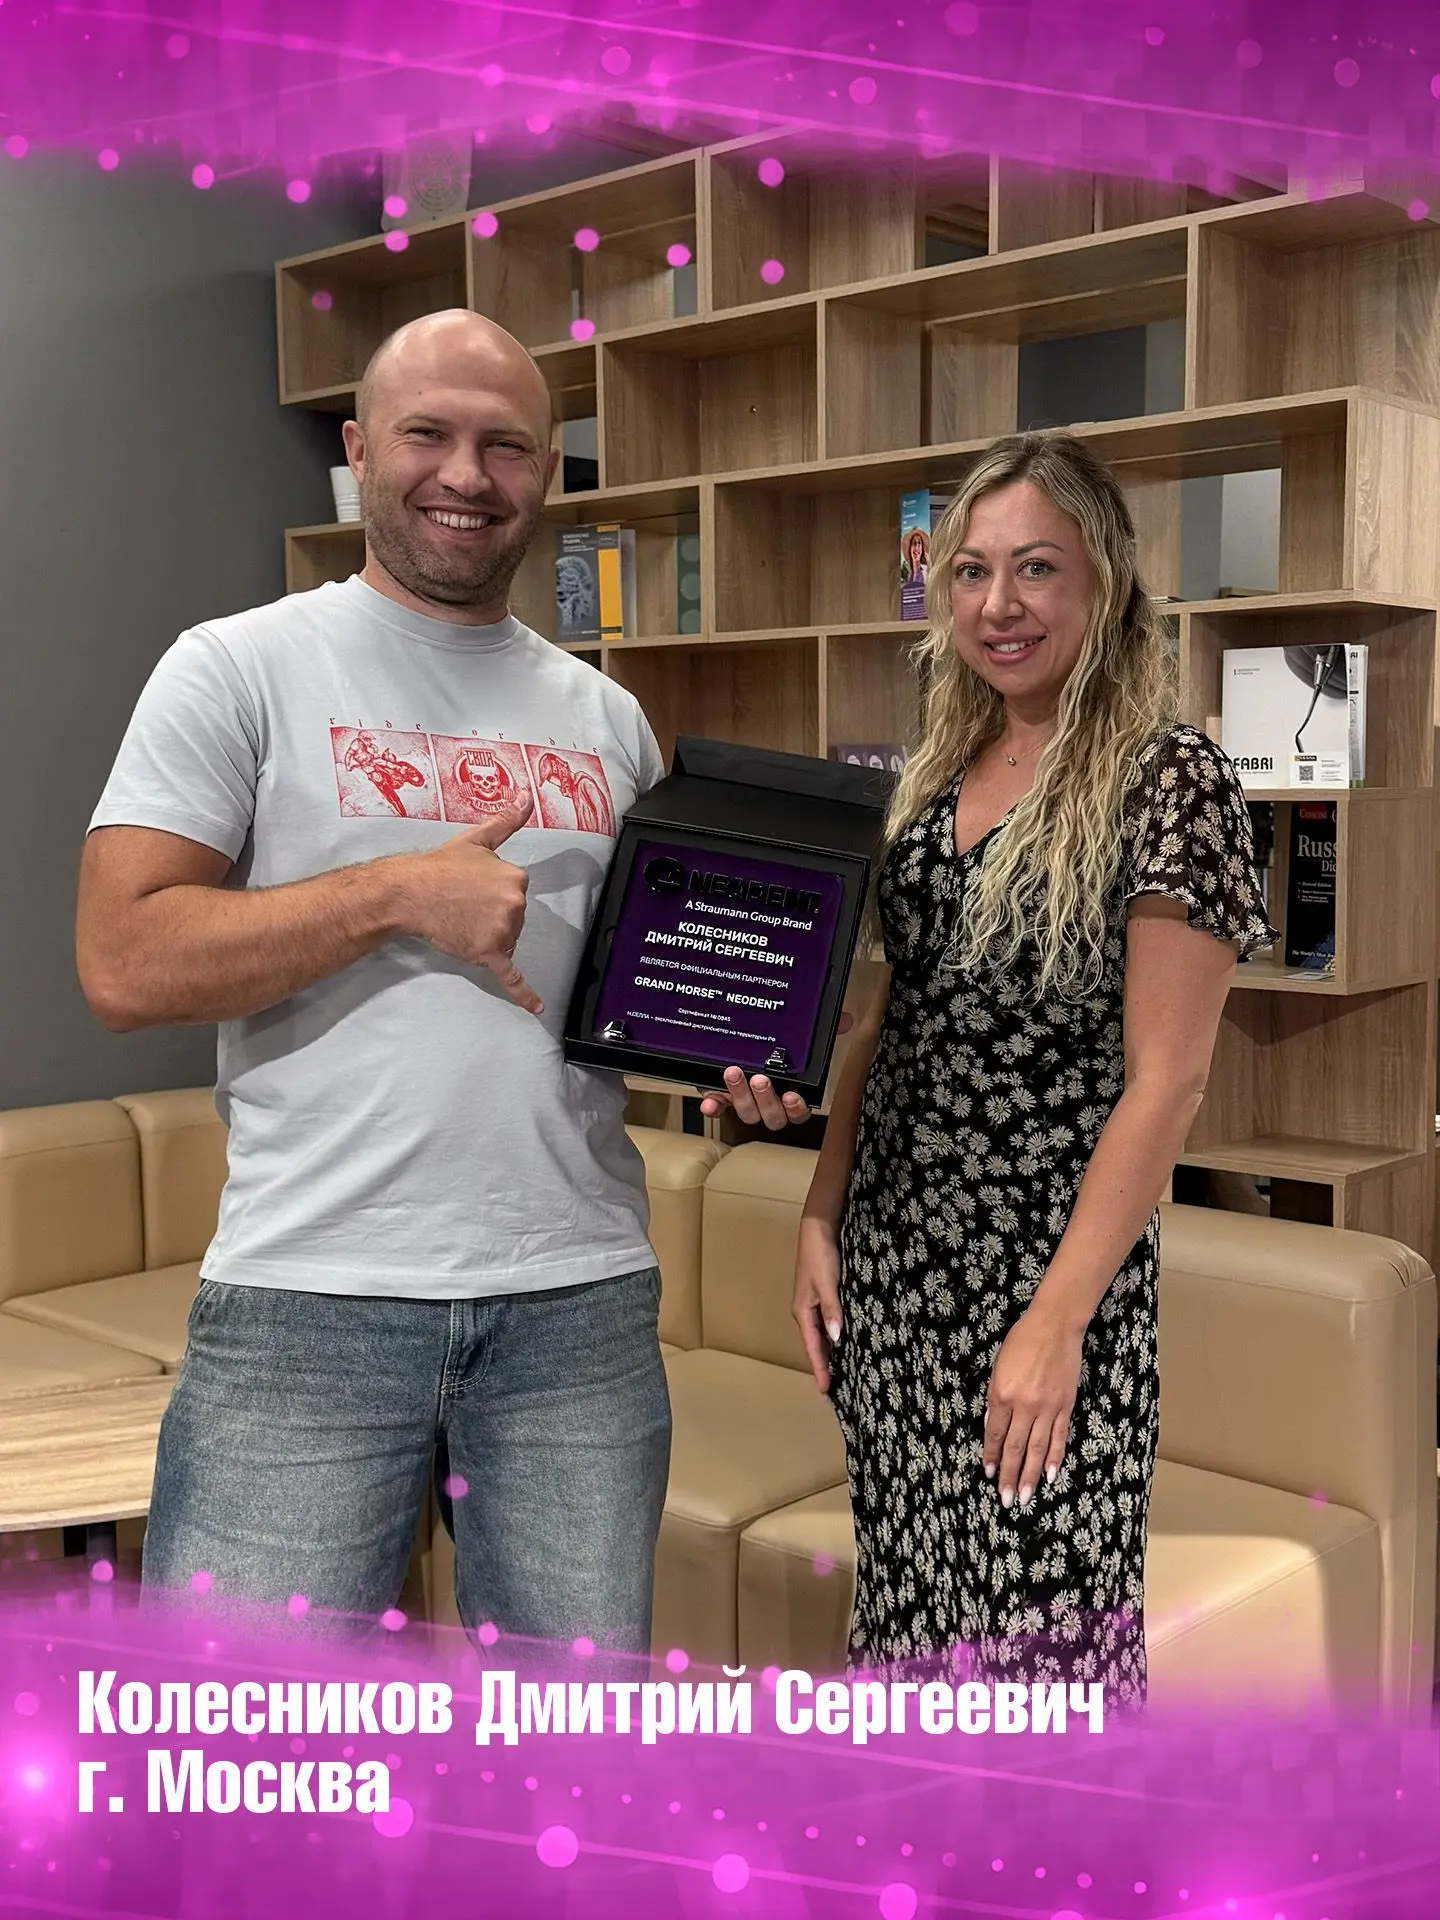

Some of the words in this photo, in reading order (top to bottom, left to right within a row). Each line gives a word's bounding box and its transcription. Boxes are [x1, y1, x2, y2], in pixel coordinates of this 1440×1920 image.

[684, 900, 694, 909] A
[695, 901, 748, 920] Straumann
[750, 911, 781, 927] Group
[782, 917, 812, 931] Brand
[645, 930, 712, 953] ДМИТРИЙ
[715, 943, 794, 967] СЕРГЕЕВИЧ
[678, 921, 768, 947] КОЛЕСНИКОВ
[634, 976, 675, 991] GRAND
[639, 955, 680, 970] ЯВЛЯЕТСЯ
[680, 963, 741, 981] ОФИЦИАЛЬНЫМ
[742, 974, 789, 989] ПАРТНЕРОМ
